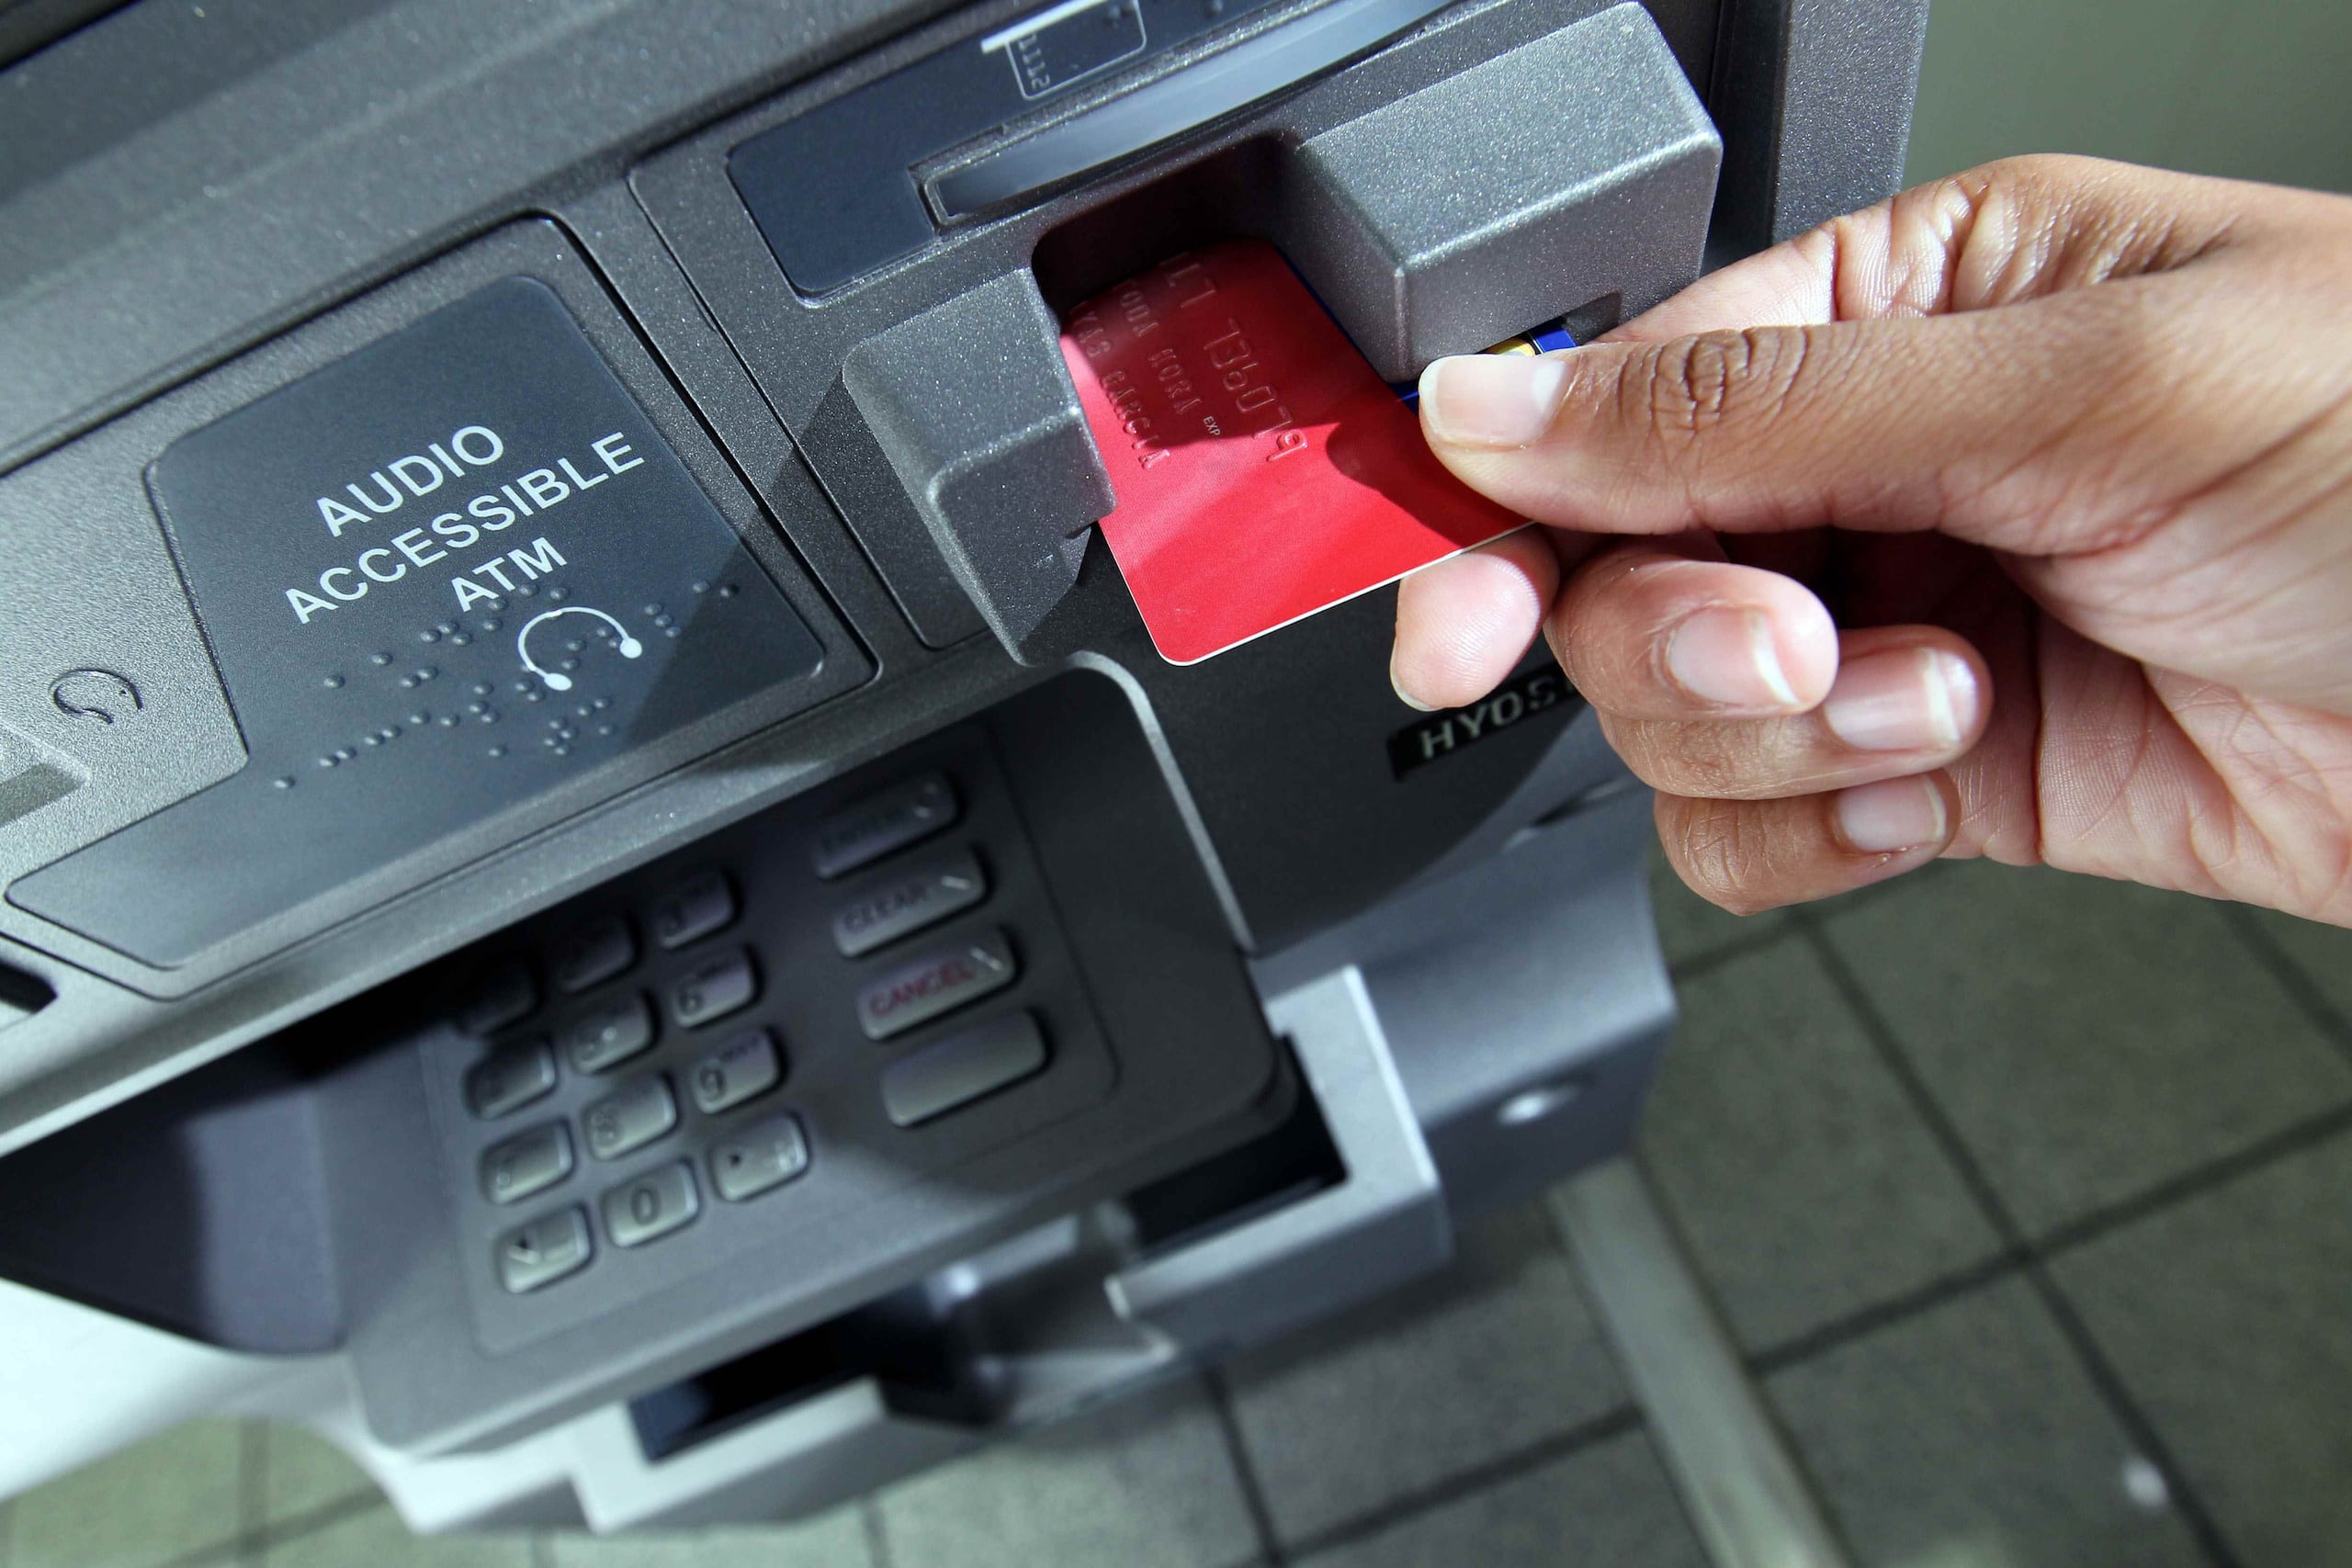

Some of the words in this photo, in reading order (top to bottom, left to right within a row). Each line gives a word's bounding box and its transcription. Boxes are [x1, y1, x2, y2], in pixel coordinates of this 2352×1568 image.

[1203, 415, 1222, 437] EXP
[316, 425, 504, 536] AUDIO
[284, 432, 645, 625] ACCESSIBLE
[450, 536, 567, 613] ATM
[869, 960, 979, 1018] CANCEL
